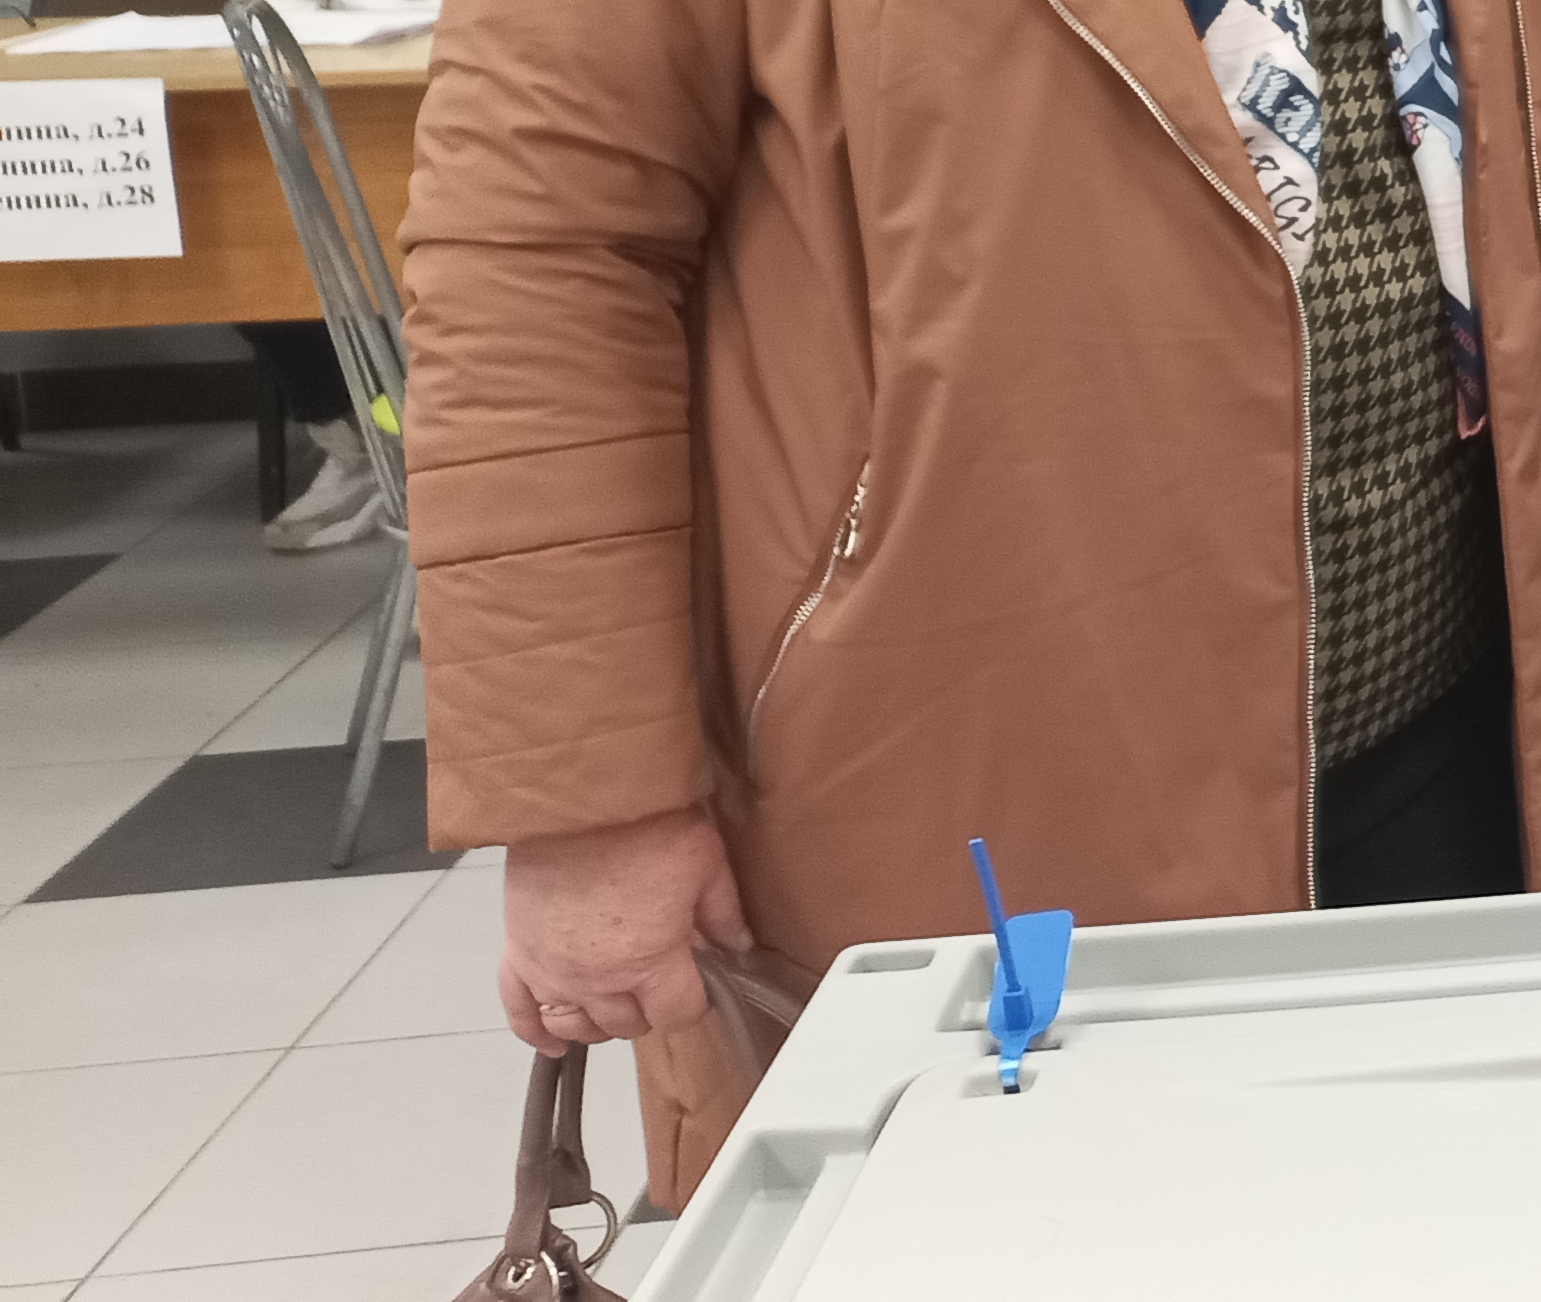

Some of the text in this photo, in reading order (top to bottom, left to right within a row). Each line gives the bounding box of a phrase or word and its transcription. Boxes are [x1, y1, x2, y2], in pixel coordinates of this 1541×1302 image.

[89, 116, 145, 141] д.24
[93, 150, 151, 175] д.26
[97, 184, 156, 209] д.28
